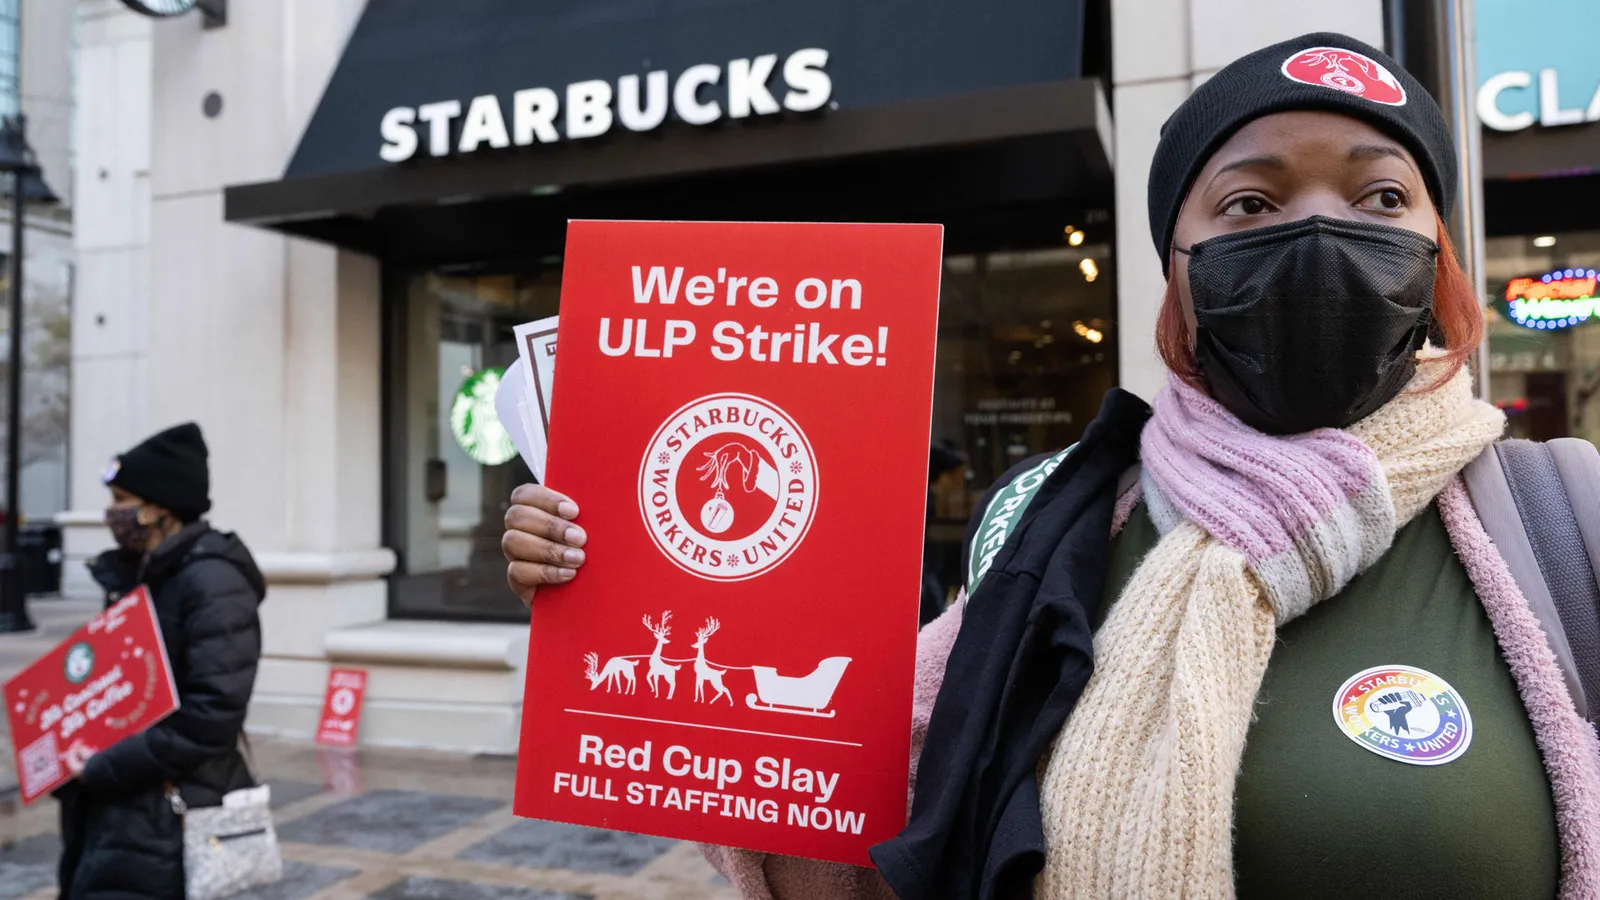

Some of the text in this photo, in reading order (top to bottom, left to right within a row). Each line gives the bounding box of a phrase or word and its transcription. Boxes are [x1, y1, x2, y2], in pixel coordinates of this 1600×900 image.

[379, 48, 832, 162] STARBUCKS
[1477, 67, 1600, 131] CL
[631, 266, 862, 310] We're on
[598, 317, 889, 367] ULP Strike!
[666, 406, 798, 460] STARBUCKS
[652, 468, 722, 567] WORKERS
[742, 478, 804, 565] UNITED
[578, 734, 840, 803] Red Cup Slay
[1417, 722, 1458, 753] UNITED
[553, 772, 866, 835] FULL STAFFING NOW
